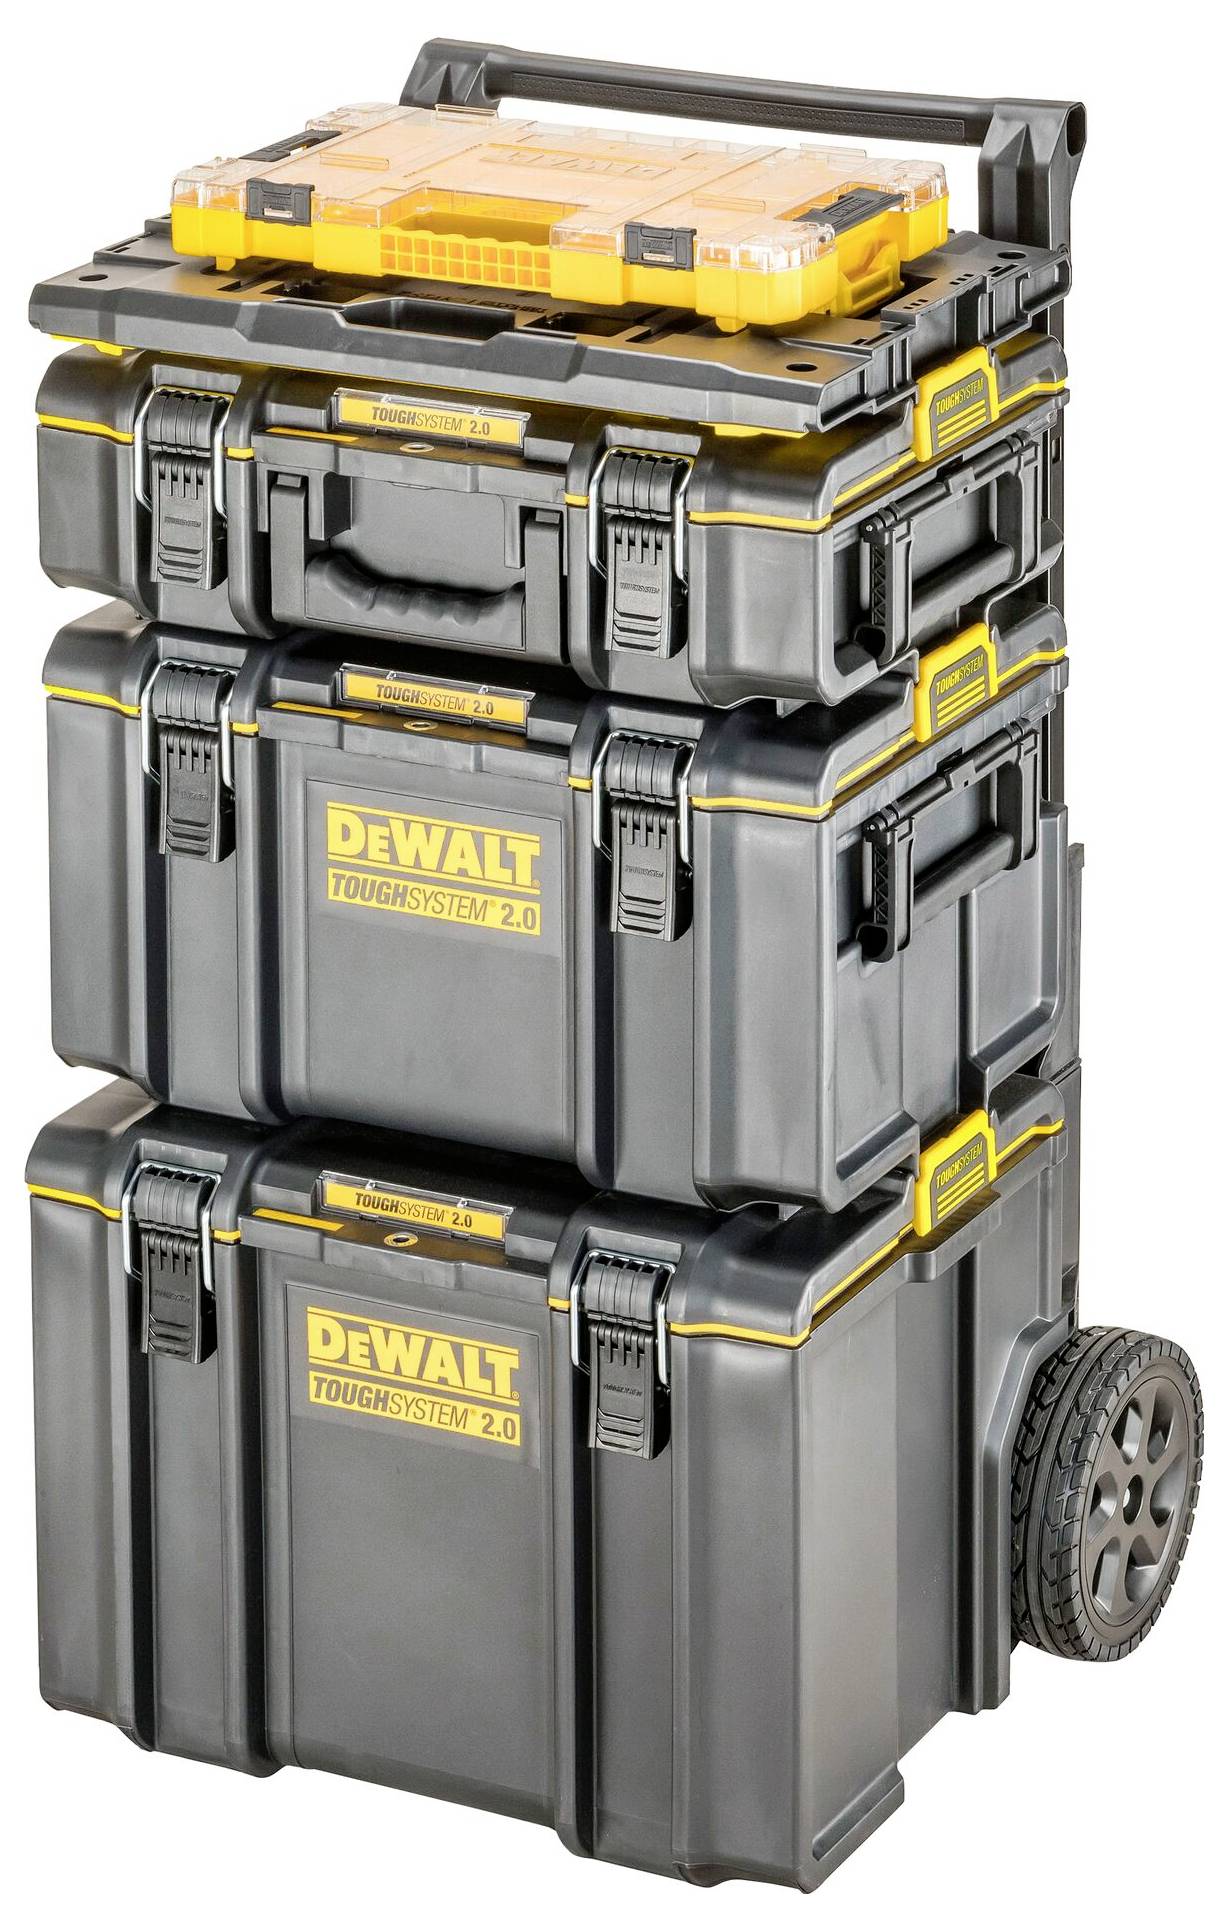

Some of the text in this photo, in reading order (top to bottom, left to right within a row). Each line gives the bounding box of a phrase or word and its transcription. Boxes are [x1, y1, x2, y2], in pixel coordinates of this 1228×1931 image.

[936, 377, 984, 417] TOUGHSYSTEM
[372, 406, 490, 436] TOUGHSYSTEM 2.0
[936, 653, 984, 697] TOUGHSYSTEM
[376, 684, 494, 715] TOUGHSYSTEM 2.0
[331, 872, 537, 931] TOUGHSYSTEM 2.0
[936, 1140, 983, 1190] TOUGHSYSTEM
[355, 1192, 473, 1228] TOUGHSYSTEM 2.0
[313, 1375, 517, 1440] TOUGHSYSTEM 2.0
